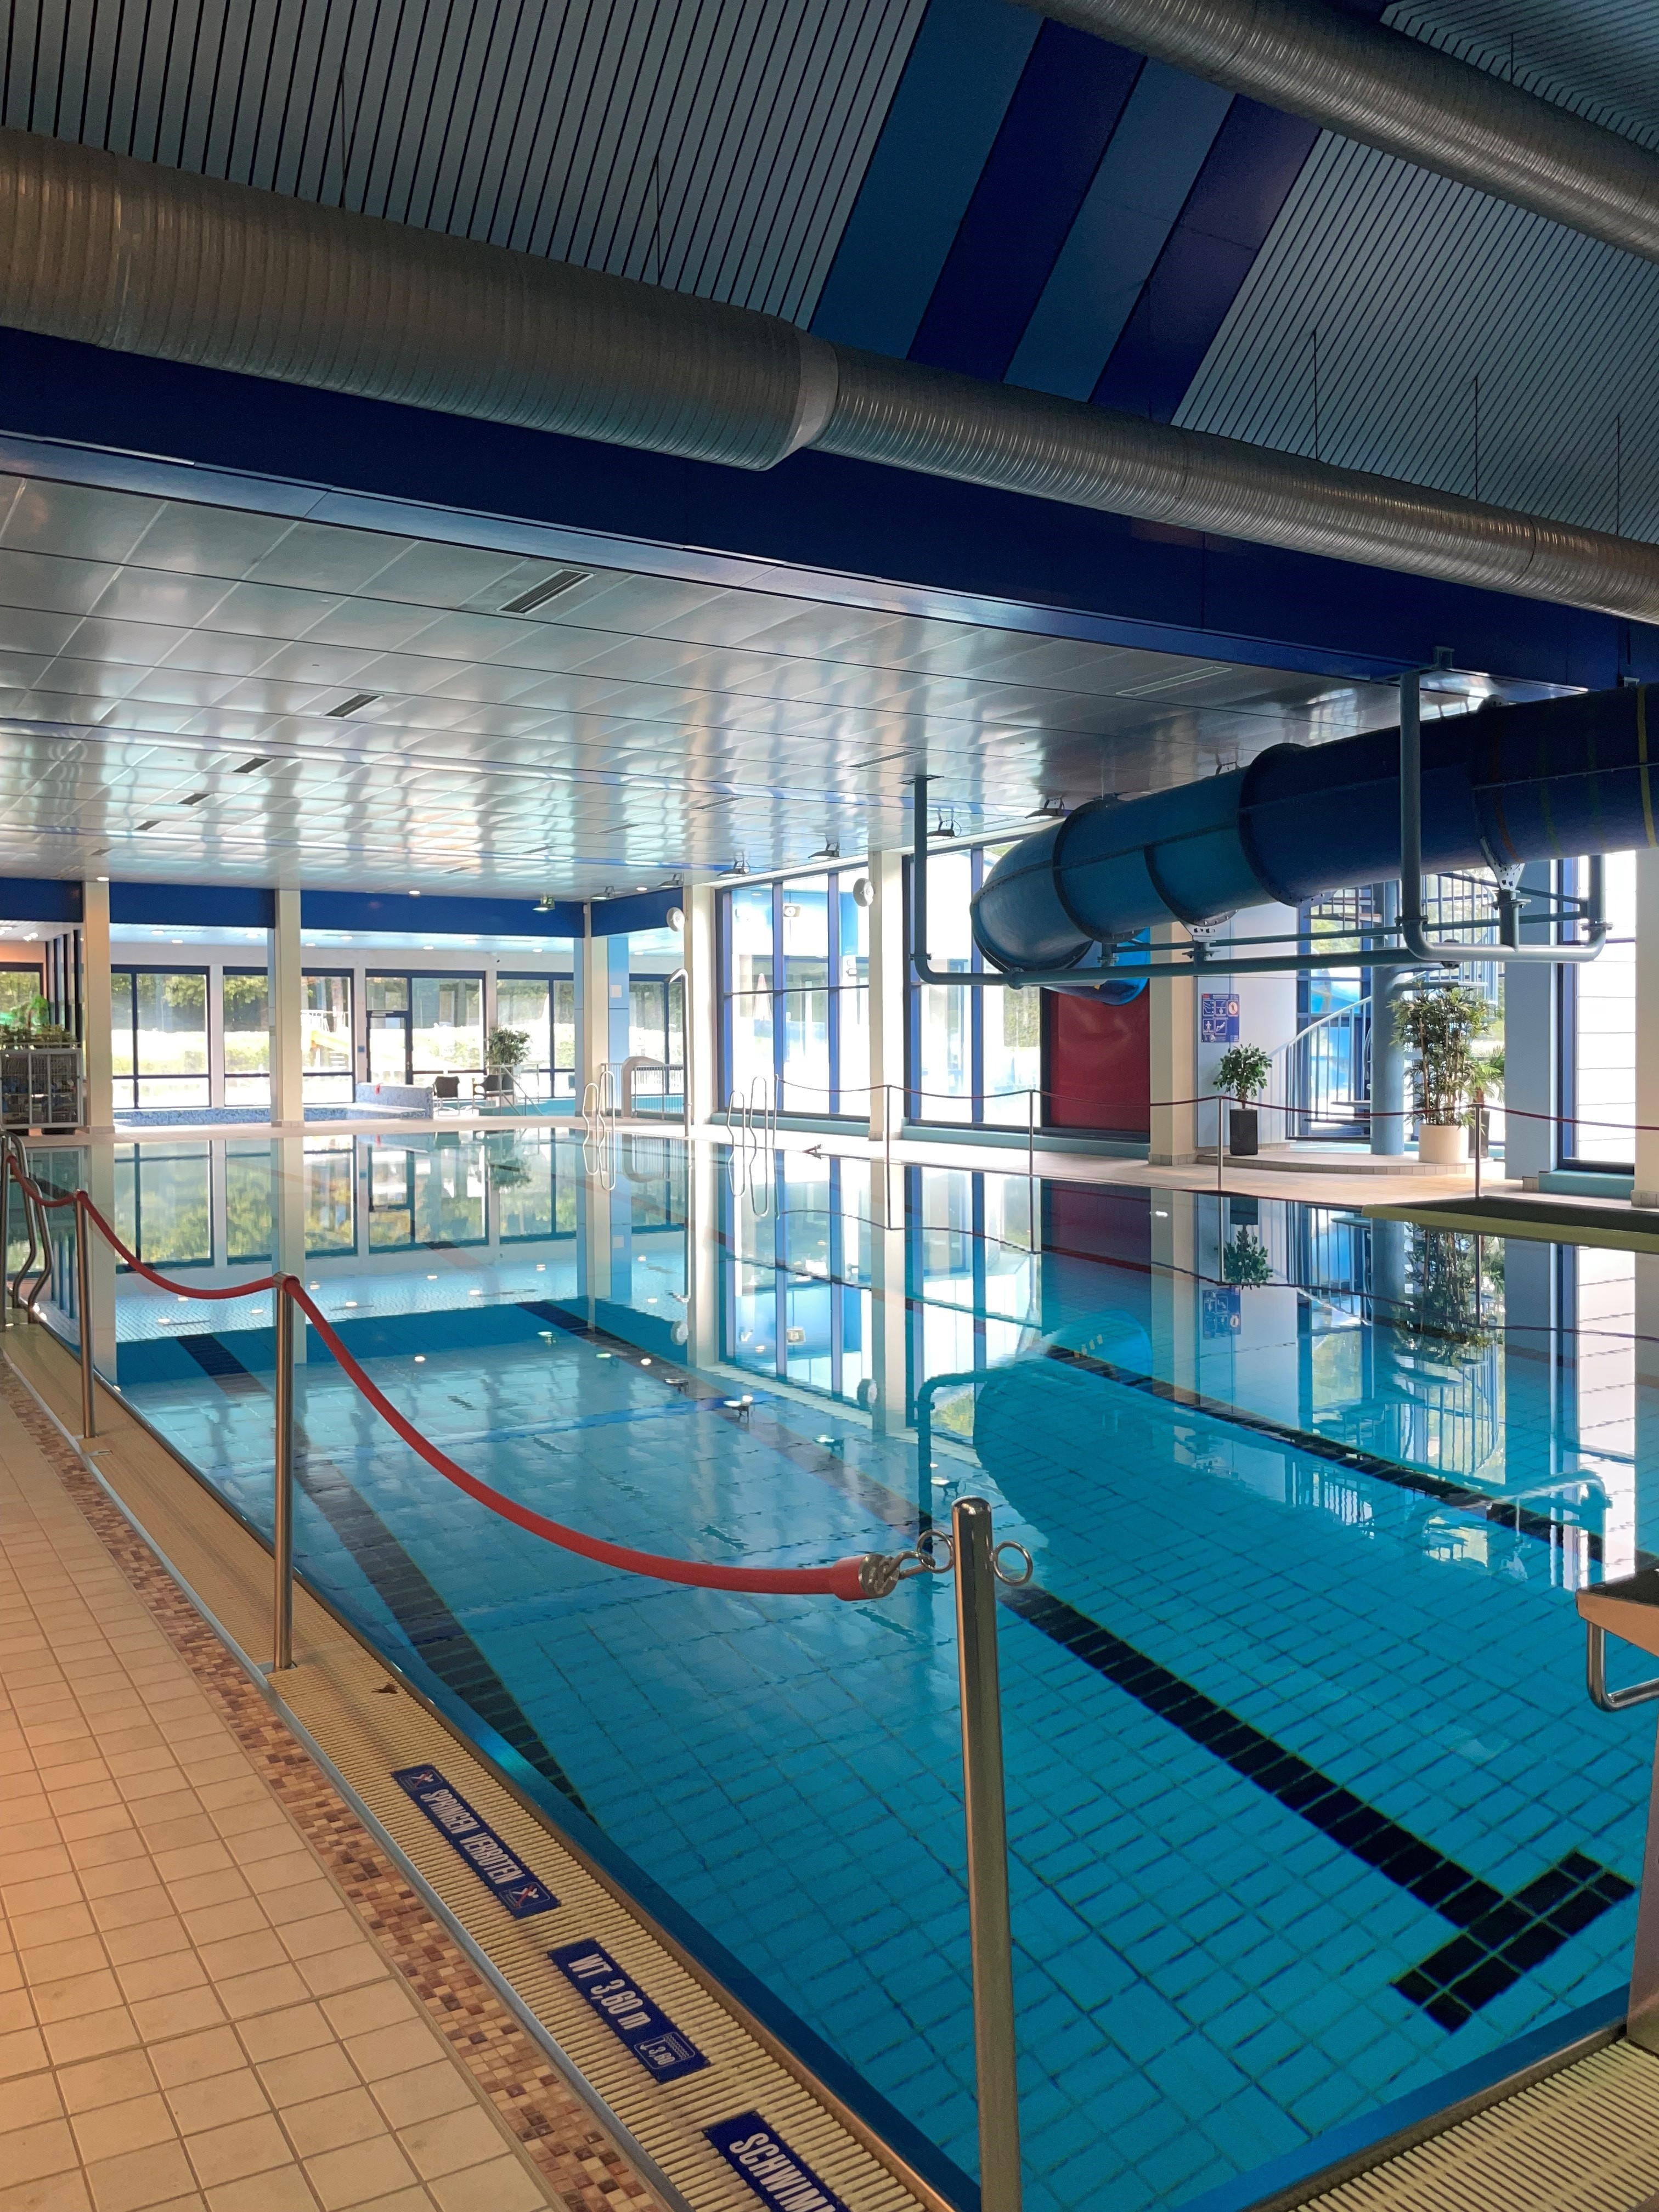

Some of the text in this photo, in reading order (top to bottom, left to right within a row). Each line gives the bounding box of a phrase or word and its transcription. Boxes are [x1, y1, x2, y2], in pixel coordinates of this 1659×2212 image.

[420, 1788, 526, 1884] SPRINGEN VERBOTEN
[568, 1953, 652, 2030] WT 3,60 m
[648, 2046, 675, 2066] 3,60
[729, 2132, 836, 2212] SCHWIM
